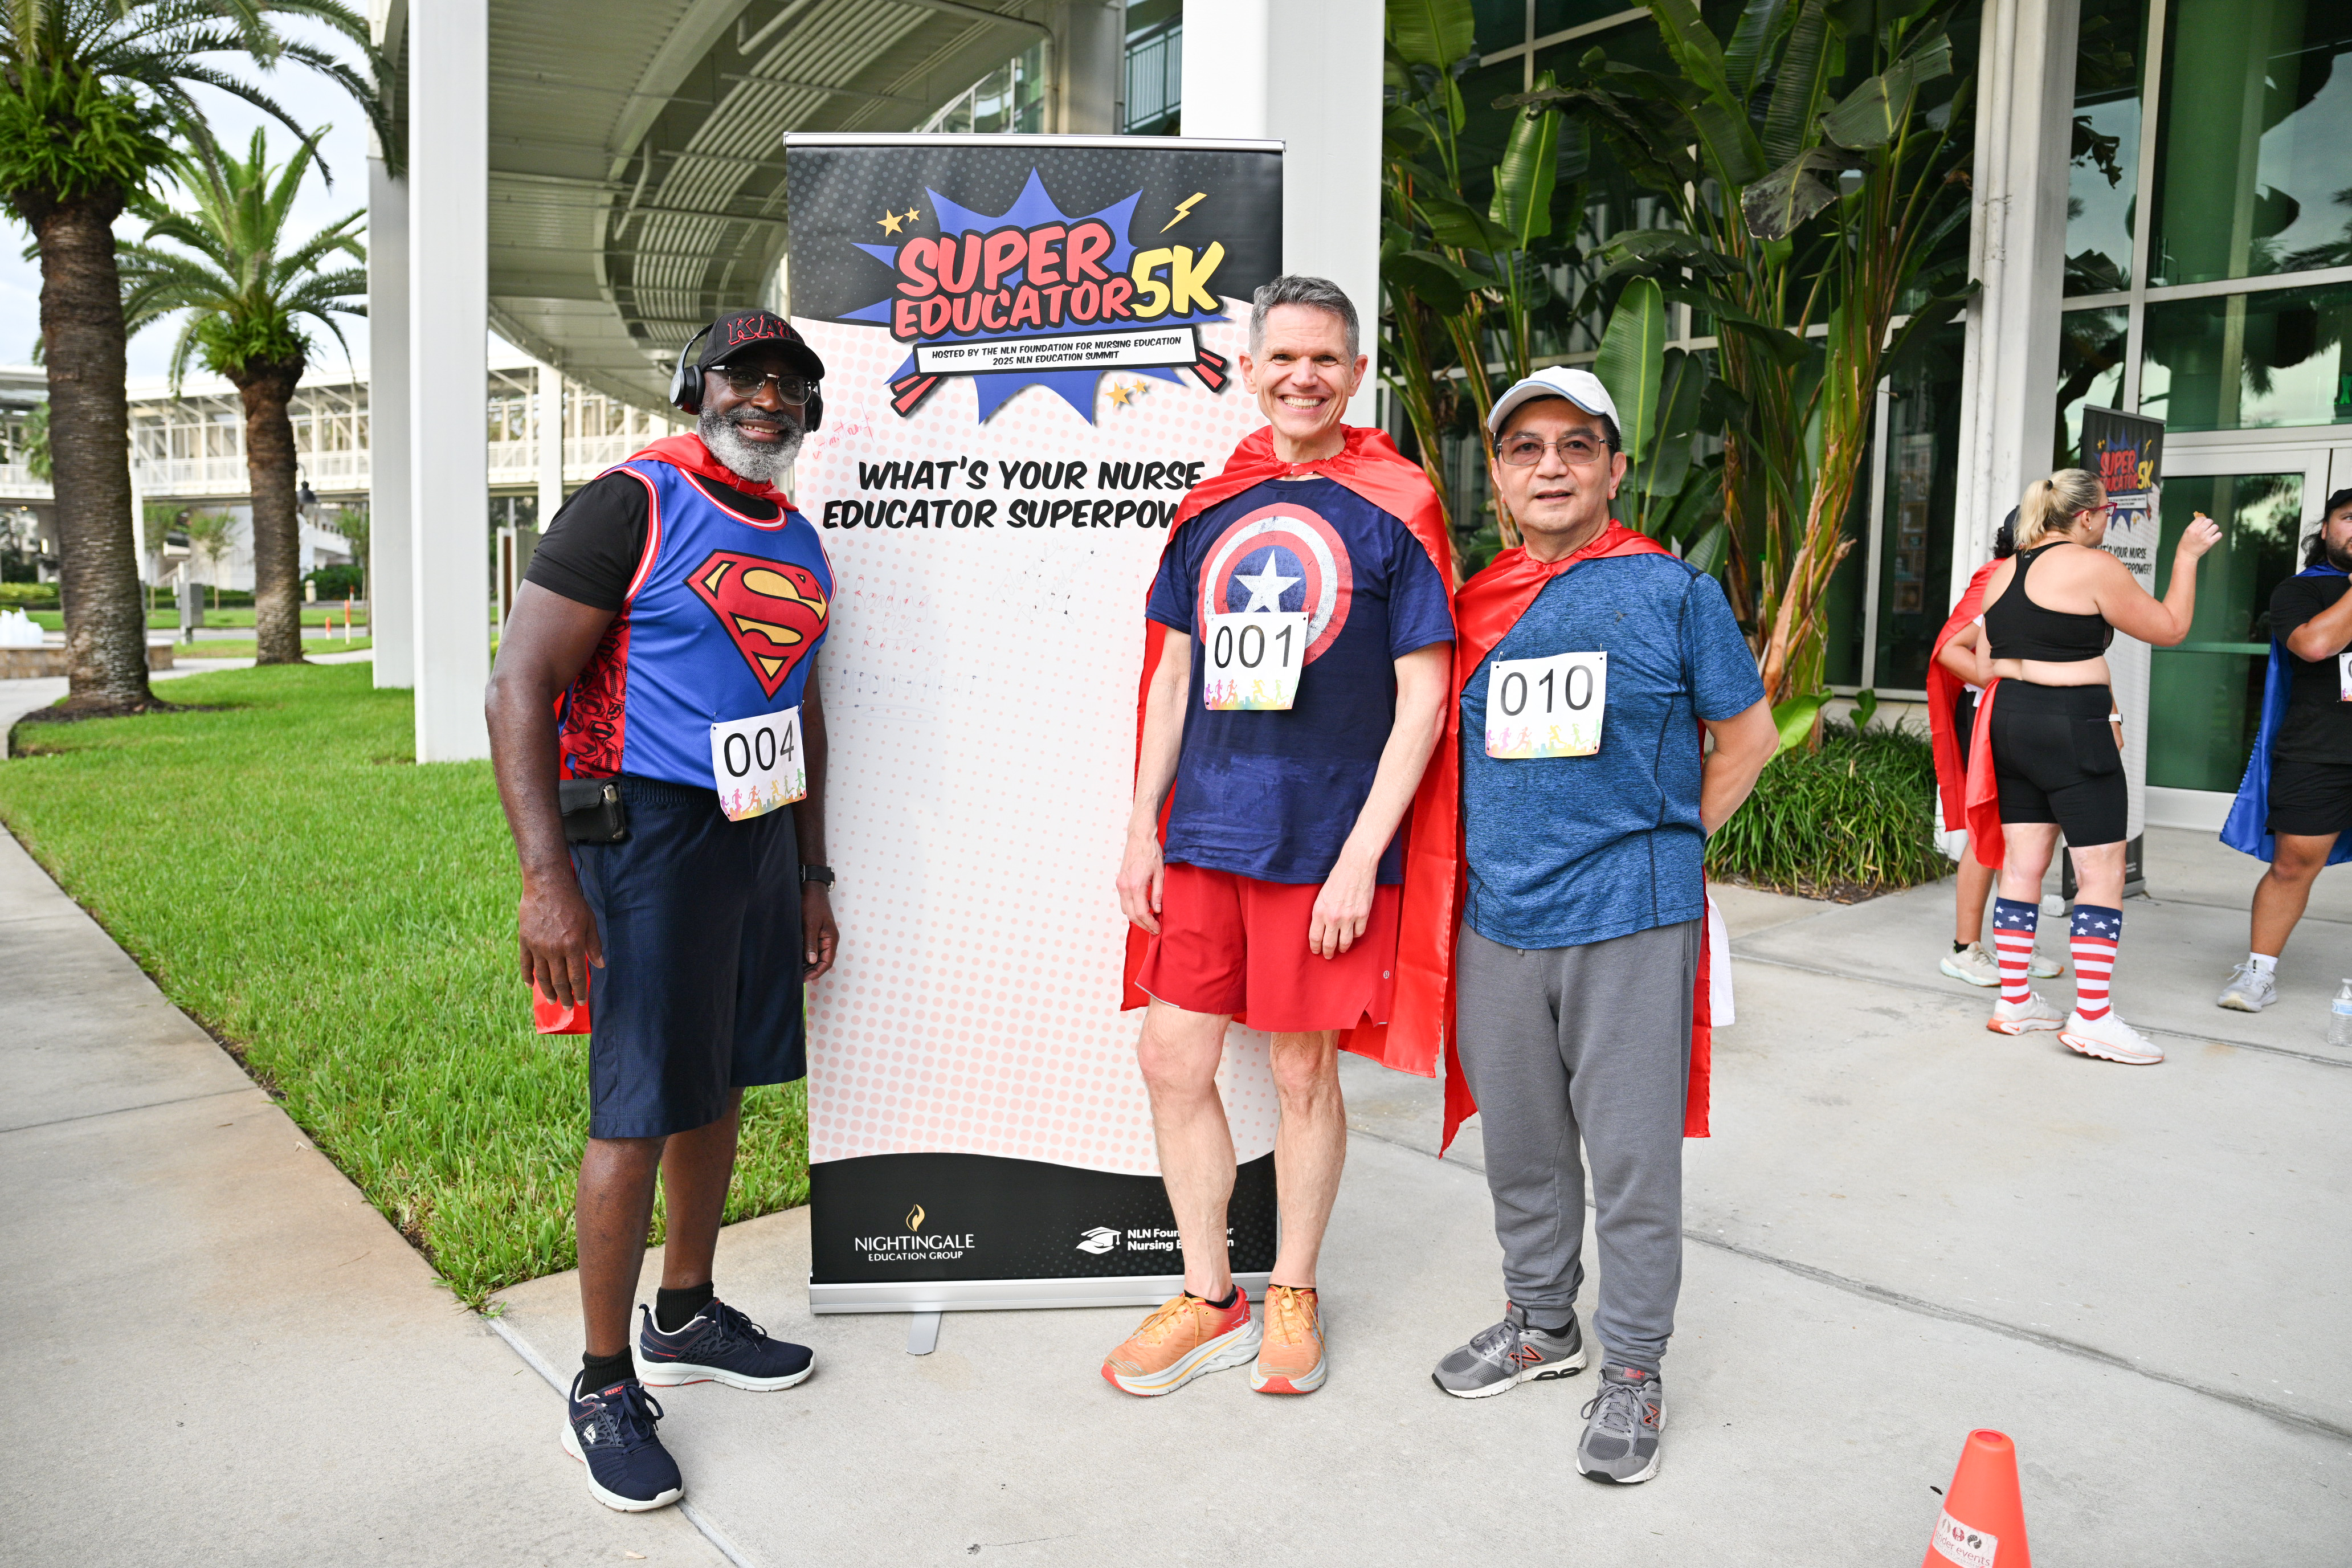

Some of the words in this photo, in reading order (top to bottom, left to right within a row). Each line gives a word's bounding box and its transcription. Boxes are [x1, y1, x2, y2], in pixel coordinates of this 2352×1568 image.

[897, 223, 1110, 297] SUPER
[1132, 240, 1225, 318] 5K
[896, 283, 1132, 337] EDUCATOR
[932, 350, 965, 359] HOSTED
[967, 349, 979, 358] BY
[982, 348, 998, 356] THE
[1000, 346, 1017, 355] NLN
[1019, 343, 1073, 353] FOUNDATION
[1076, 341, 1092, 350] FOR
[1095, 340, 1132, 349] NURSING
[1134, 336, 1182, 347] EDUCATION
[993, 357, 1014, 365] 2025
[1016, 356, 1033, 364] NLN
[1035, 353, 1083, 364] EDUCATION
[1085, 350, 1120, 360] SUMMIT
[859, 456, 989, 491] WHAT'S
[999, 460, 1087, 491] YOUR
[1098, 460, 1205, 490] NURSE
[2100, 450, 2135, 476] SUPER
[2137, 459, 2154, 489] 5K
[823, 499, 995, 529] EDUCATOR
[1007, 499, 1179, 529] SUPERPOW
[2130, 547, 2146, 559] NURSE
[1214, 624, 1292, 668] 001
[1500, 665, 1593, 716] 010
[724, 720, 794, 777] 004
[855, 1234, 975, 1251] NIGHTINGALE
[1128, 1229, 1151, 1239] NLN
[1154, 1228, 1179, 1238] Foun
[1128, 1240, 1174, 1251] Nursing
[868, 1252, 926, 1261] EDUCATION
[929, 1251, 963, 1260] GROUP
[1956, 1547, 1990, 1566] events
